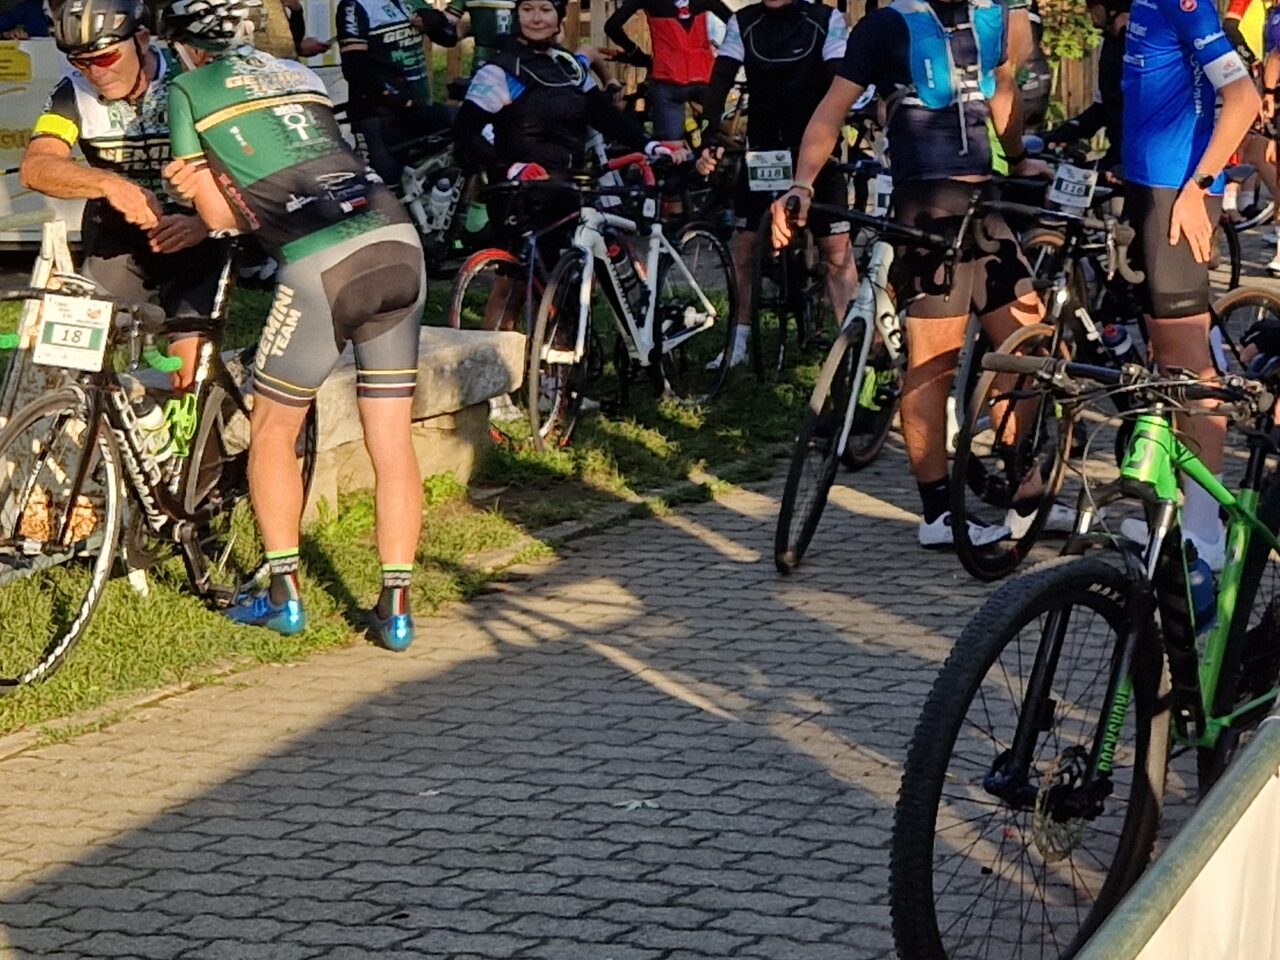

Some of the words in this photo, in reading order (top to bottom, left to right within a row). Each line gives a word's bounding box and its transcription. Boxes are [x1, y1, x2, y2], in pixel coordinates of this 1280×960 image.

[61, 329, 83, 343] 18
[255, 283, 294, 370] GEMINI
[271, 308, 302, 357] TEAM
